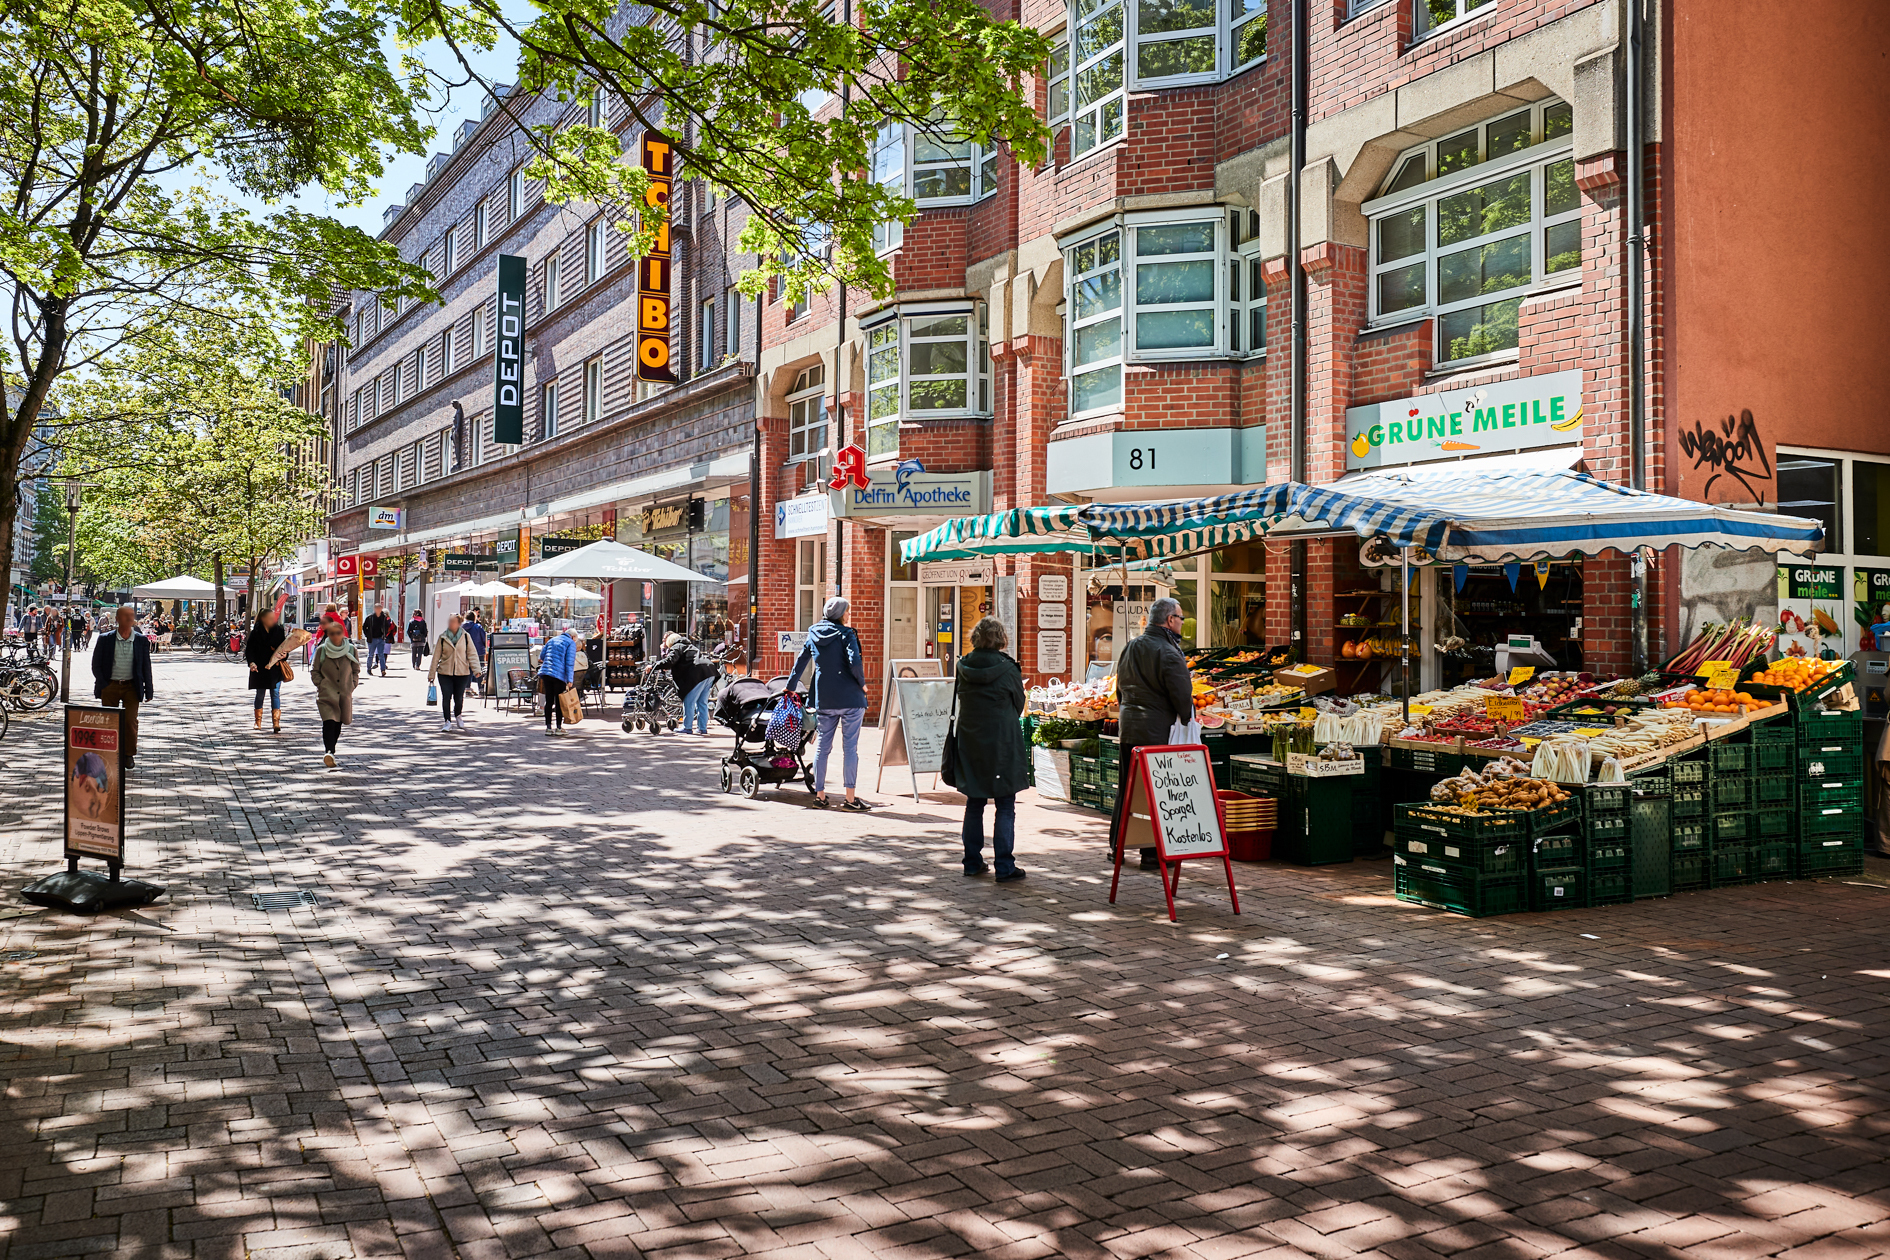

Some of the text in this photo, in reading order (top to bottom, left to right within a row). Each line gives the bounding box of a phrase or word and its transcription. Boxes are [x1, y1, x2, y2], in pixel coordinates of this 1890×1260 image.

[500, 292, 520, 406] DEPOT
[1367, 396, 1566, 447] GRÜNE MEILE
[1130, 448, 1156, 470] 81
[854, 486, 971, 507] Delfin Apotheke
[378, 511, 394, 520] dm
[651, 505, 684, 530] Tchibo
[496, 539, 517, 553] DEPOT
[602, 565, 653, 573] Tchibo
[1795, 569, 1836, 583] GRÜNE
[1873, 573, 1890, 586] GR
[497, 657, 528, 665] SPAREN!
[74, 729, 96, 746] 199€
[1155, 754, 1173, 769] Wir
[1152, 770, 1199, 789] Schälen
[1167, 788, 1189, 801] Ihren
[1159, 799, 1196, 822] Spargel
[1165, 822, 1213, 844] Kostenlos
